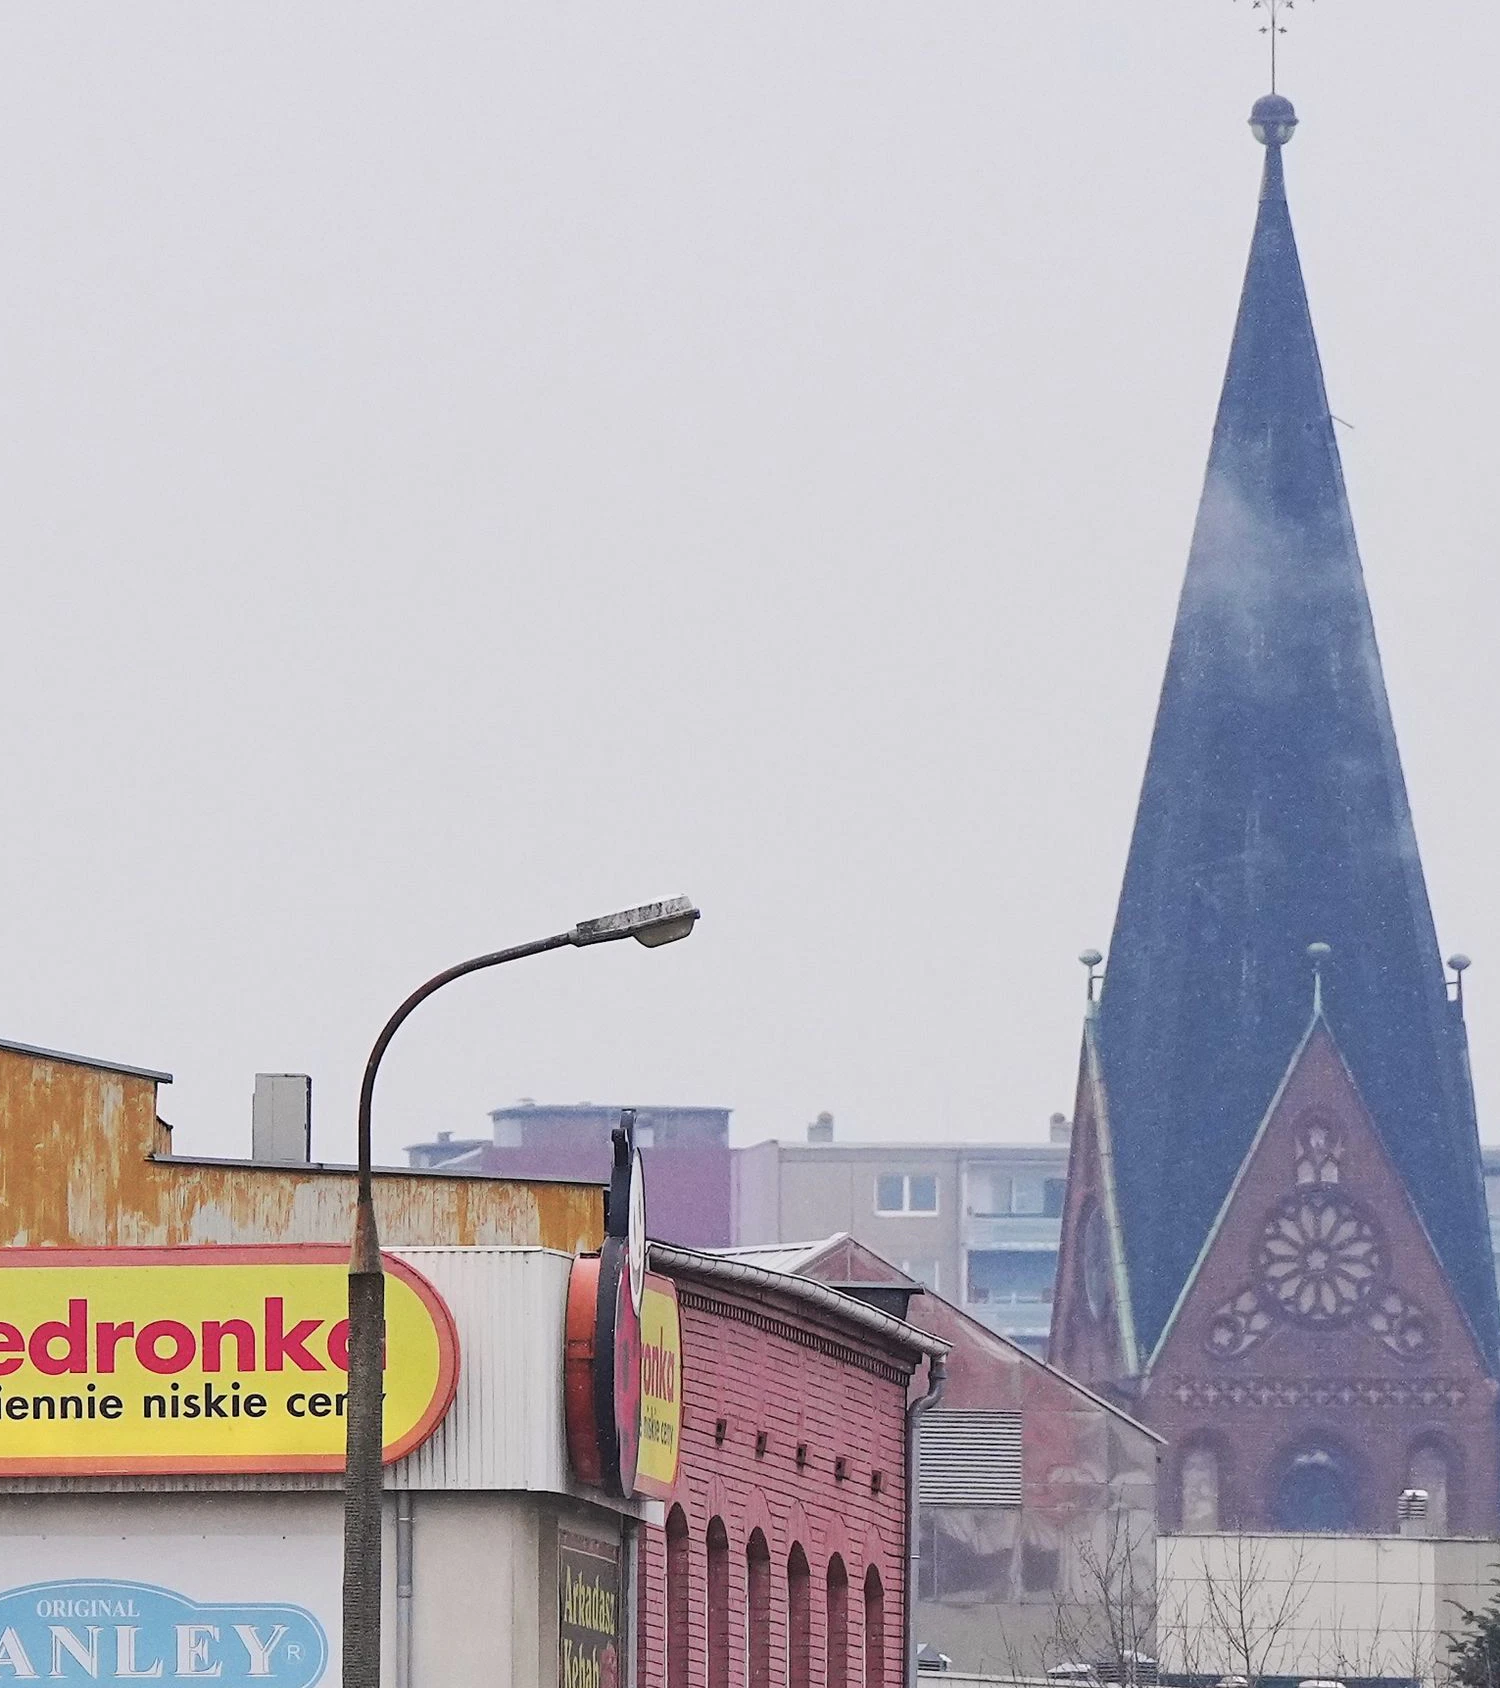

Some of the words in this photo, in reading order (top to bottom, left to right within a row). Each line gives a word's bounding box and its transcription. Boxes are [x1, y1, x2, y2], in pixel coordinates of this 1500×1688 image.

[143, 1382, 268, 1420] niskie
[286, 1392, 387, 1418] cen
[36, 1599, 140, 1618] ORIGINAL
[563, 1565, 615, 1636] Arkadasz
